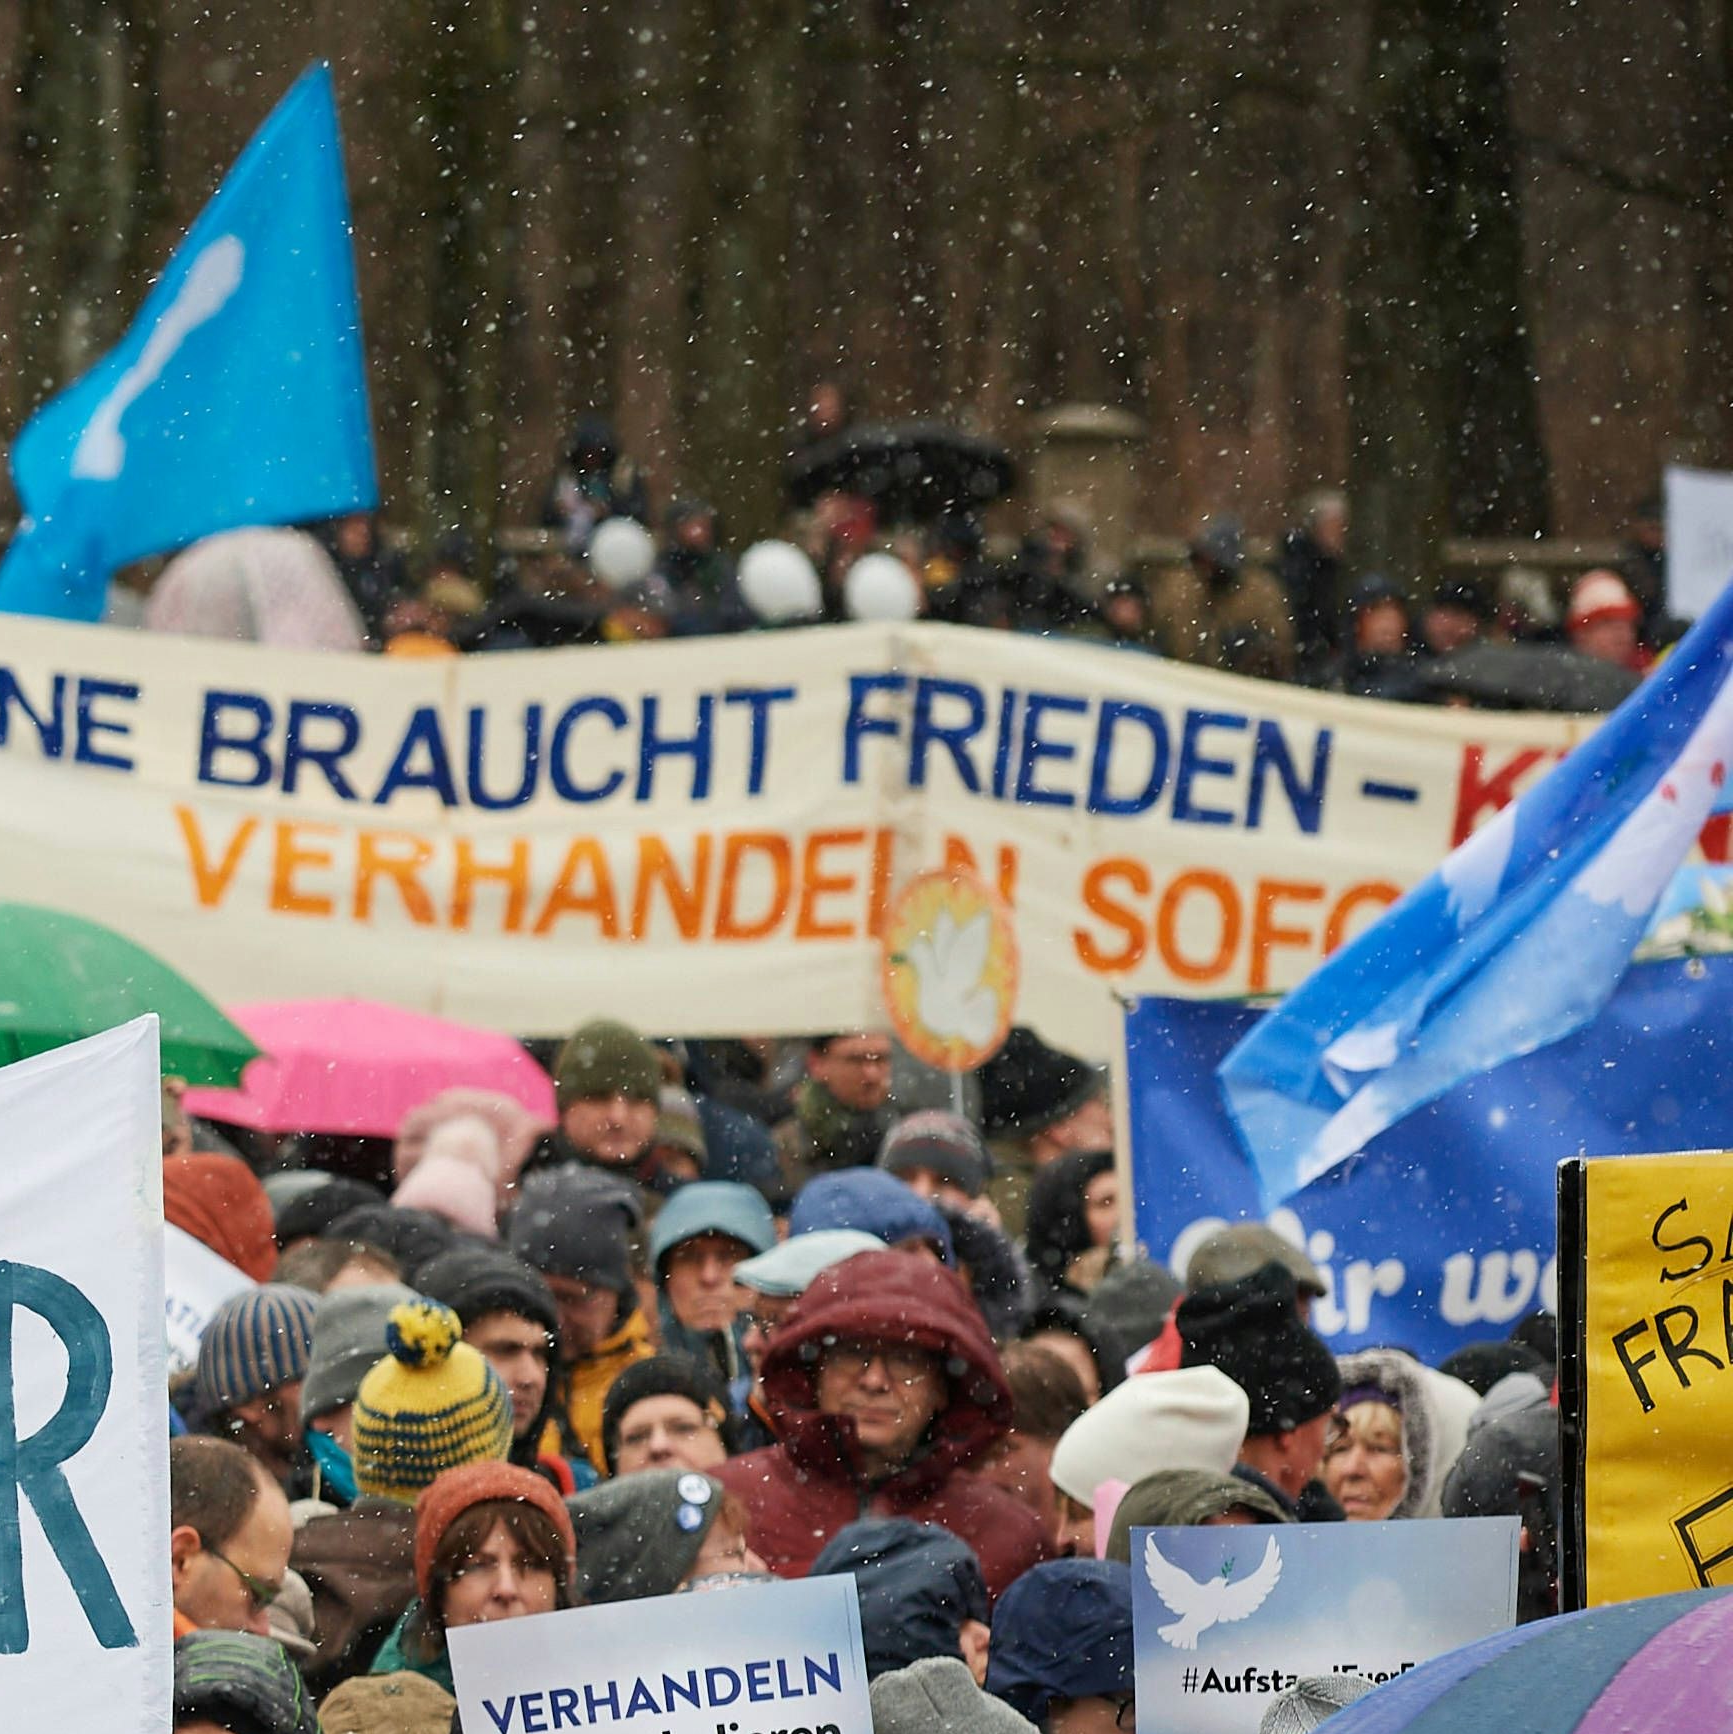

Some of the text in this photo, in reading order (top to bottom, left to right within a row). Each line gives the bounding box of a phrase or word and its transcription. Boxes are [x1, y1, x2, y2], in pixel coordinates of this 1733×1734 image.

[197, 686, 797, 811] BRAUCHT
[844, 672, 1333, 834] FRIEDEN
[1652, 1198, 1733, 1284] S
